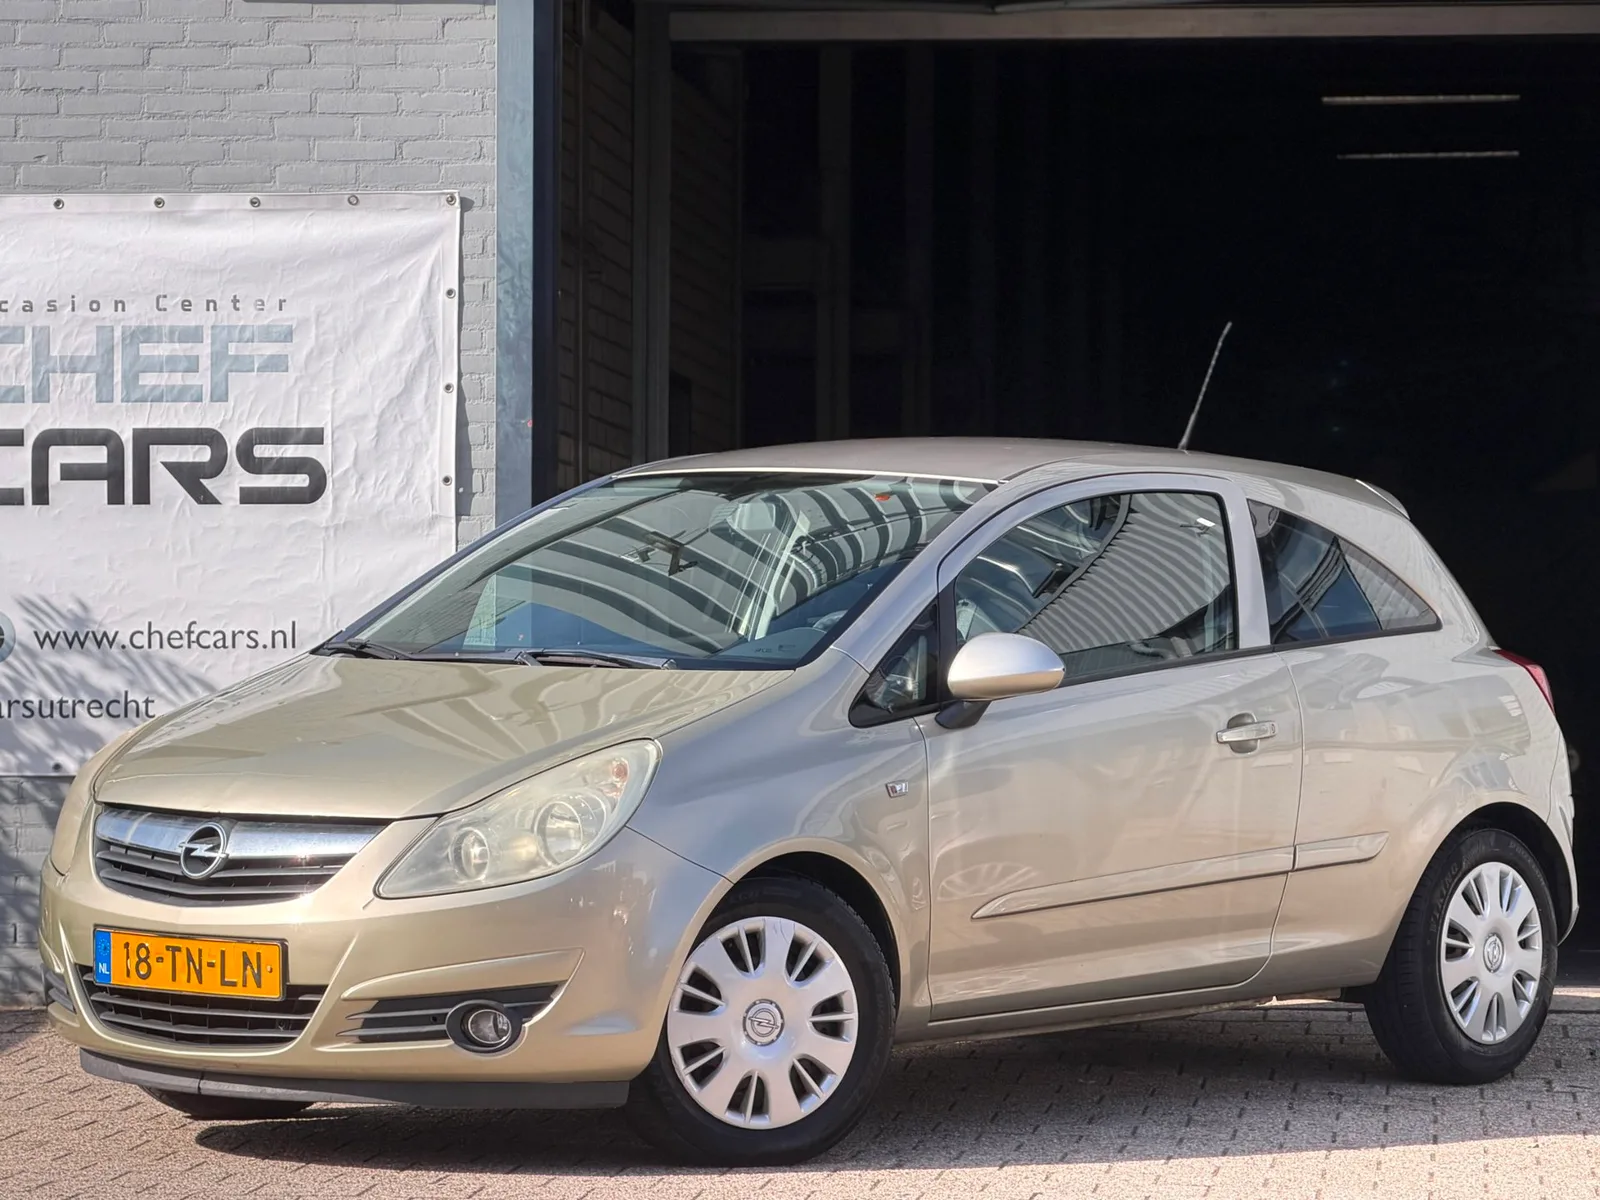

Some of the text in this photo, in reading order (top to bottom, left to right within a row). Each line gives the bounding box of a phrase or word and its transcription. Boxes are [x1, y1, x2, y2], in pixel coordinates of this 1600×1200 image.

[155, 294, 288, 313] Center
[98, 962, 110, 975] NL
[123, 941, 262, 989] 18-TN-LN
